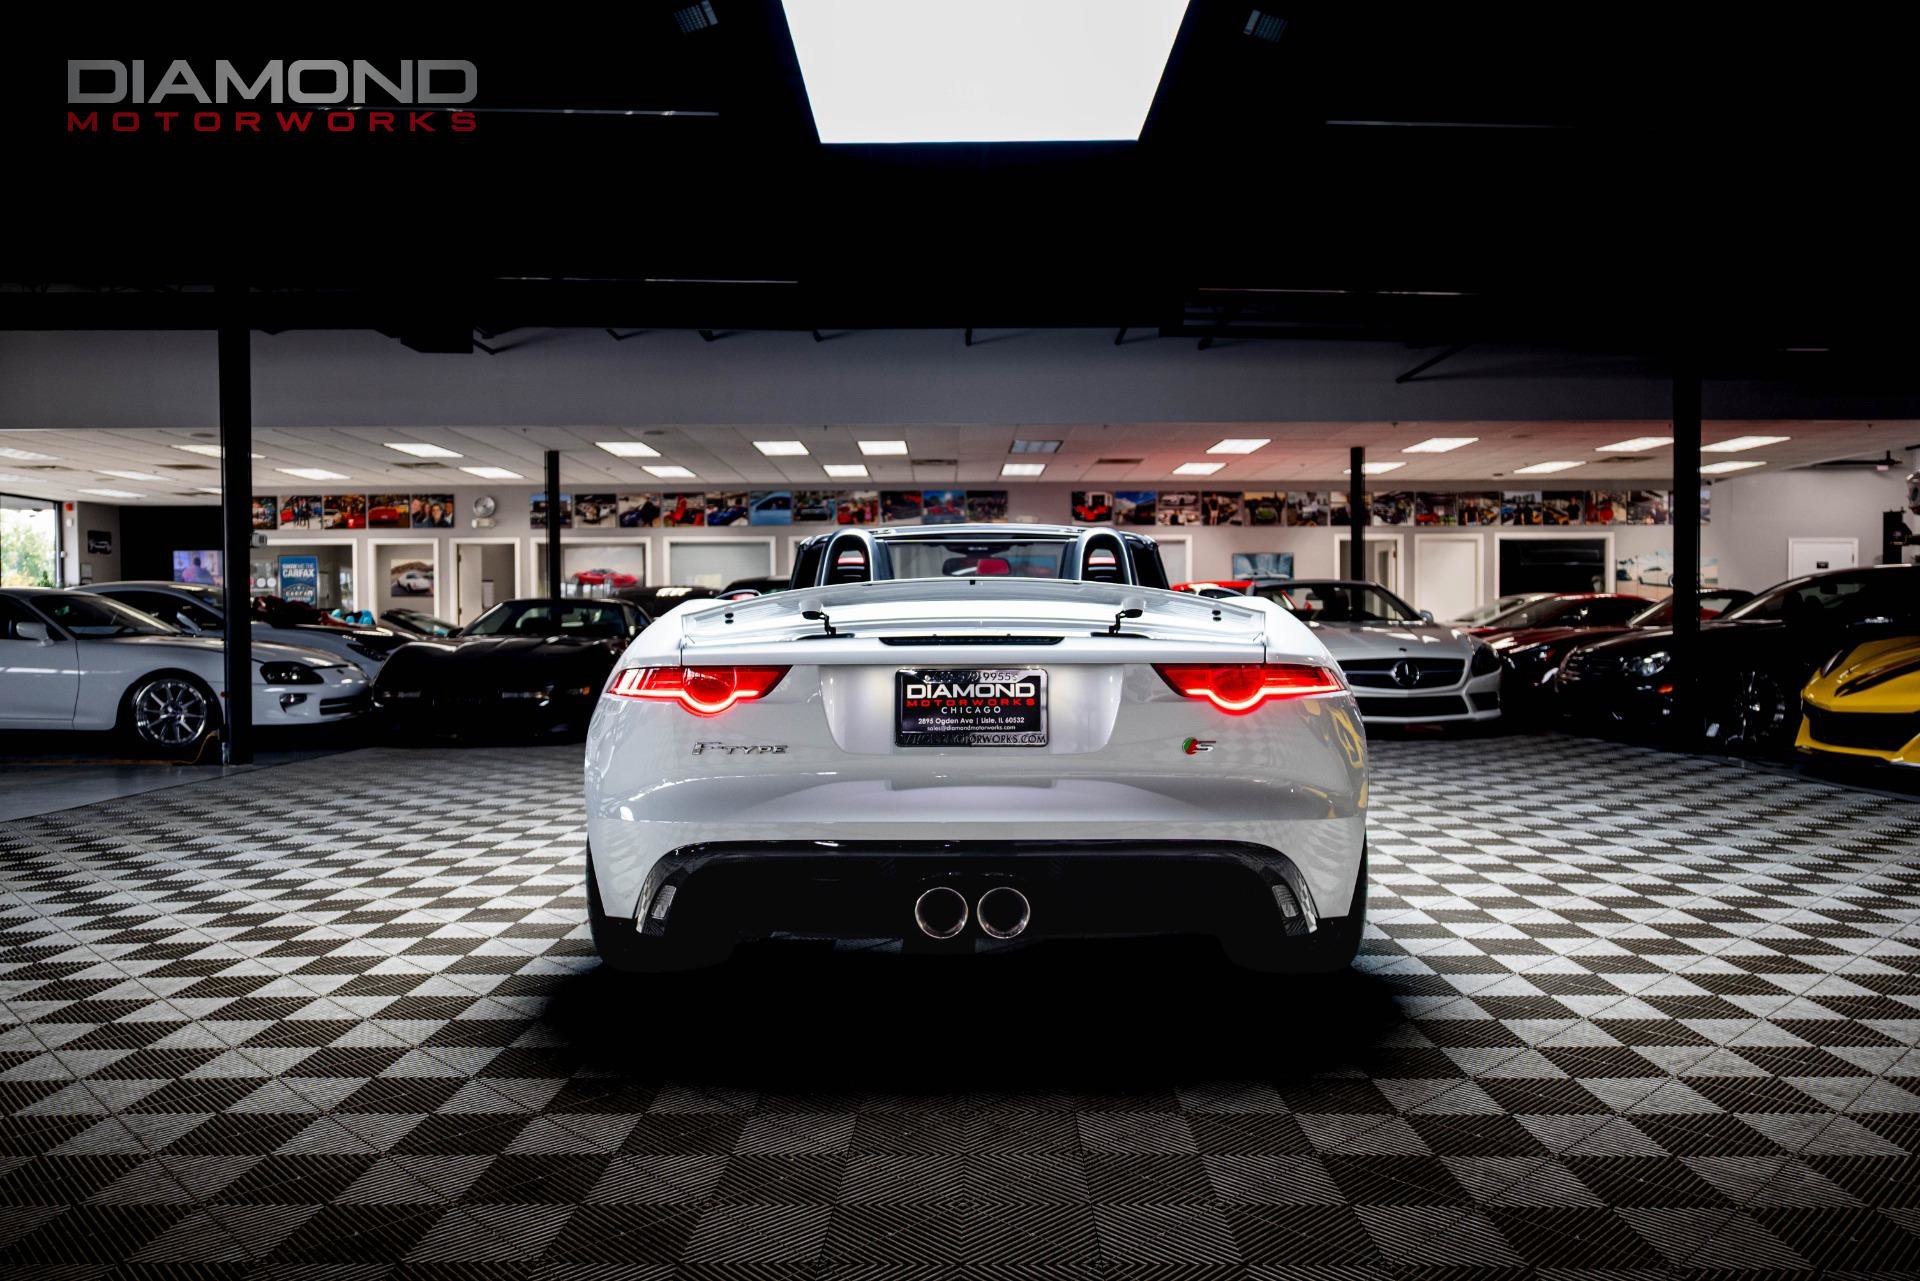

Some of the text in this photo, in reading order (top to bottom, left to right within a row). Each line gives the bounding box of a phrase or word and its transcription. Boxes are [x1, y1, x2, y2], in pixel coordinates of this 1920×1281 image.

[282, 568, 315, 578] CARFAX
[906, 683, 1035, 699] DIAMOND
[906, 698, 1036, 707] MOTORWORKS
[941, 706, 1001, 714] CHICAGO
[918, 717, 934, 725] 2895
[935, 717, 959, 726] Ogden
[1005, 716, 1025, 724] 60532
